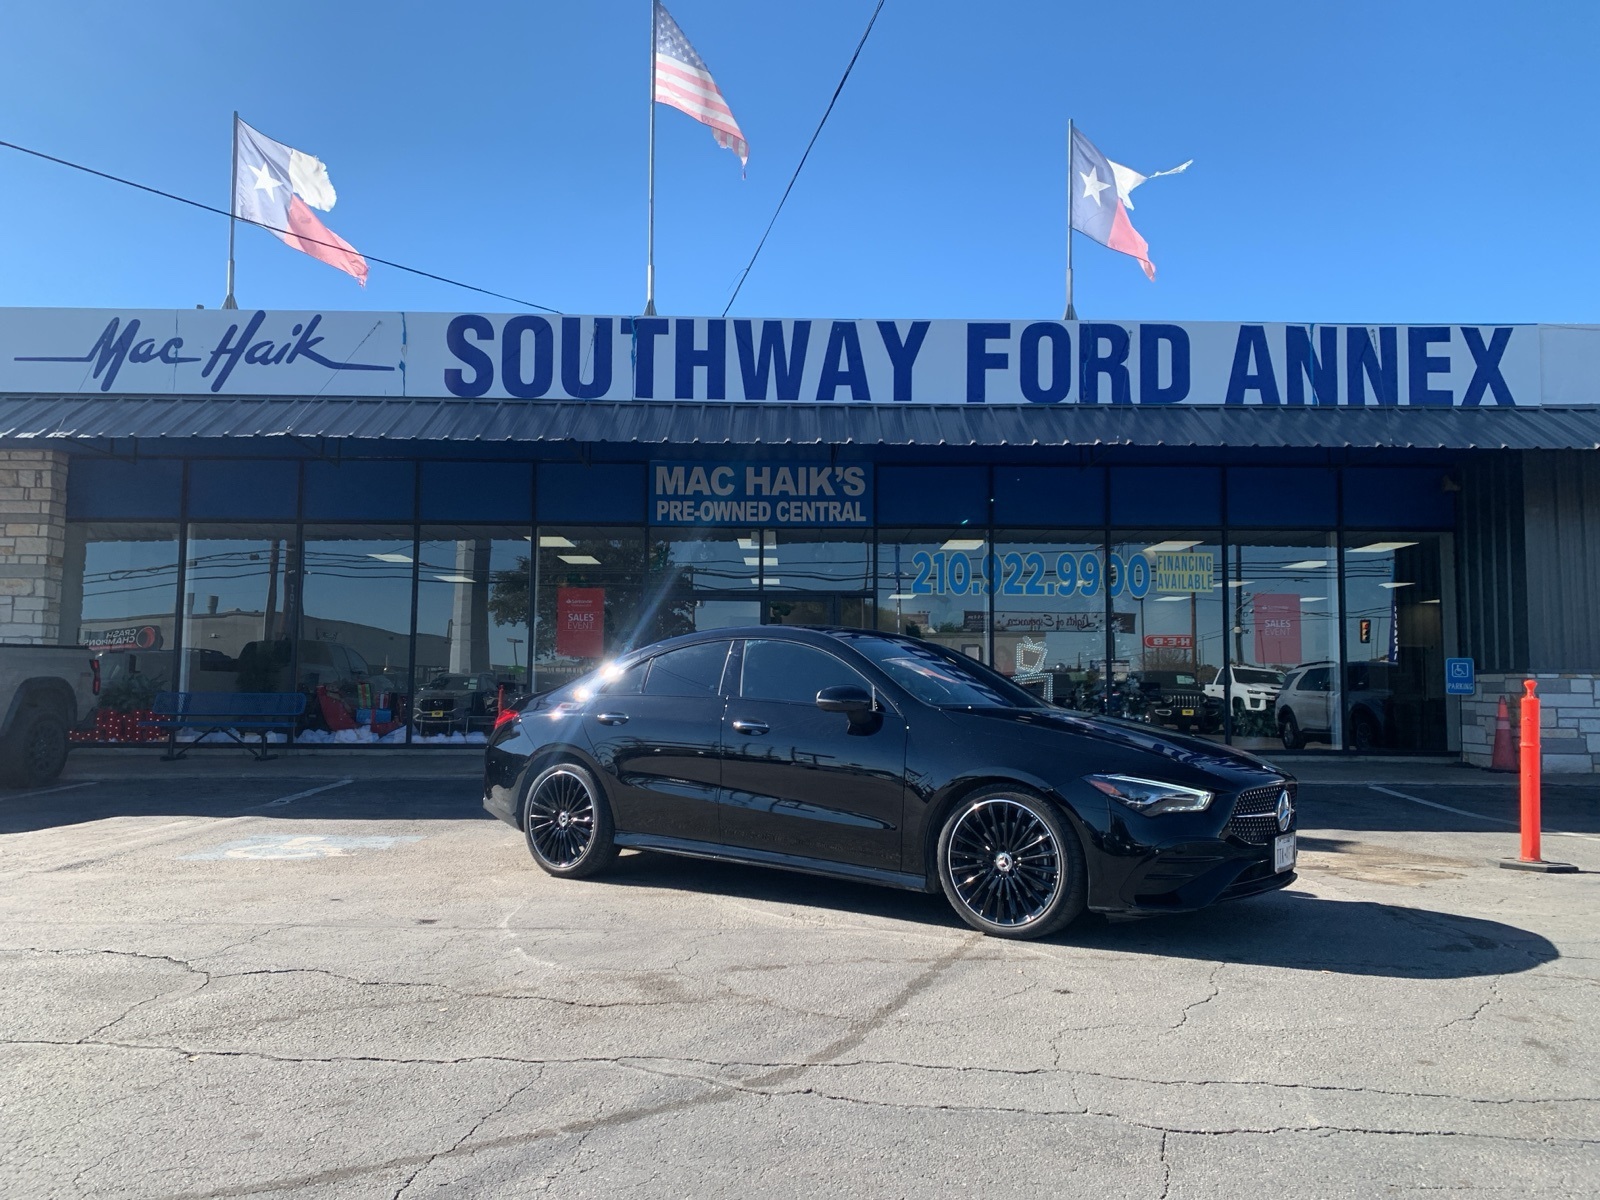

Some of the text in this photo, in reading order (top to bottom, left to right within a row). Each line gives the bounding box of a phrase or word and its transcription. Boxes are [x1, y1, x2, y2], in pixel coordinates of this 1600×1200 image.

[200, 309, 396, 393] Haik
[444, 314, 1516, 407] SOUTHWAY FORD ANNEX
[655, 466, 866, 496] MAC HAIK'S
[656, 501, 866, 522] PRE-OWNED CENTRAL
[1157, 555, 1212, 572] FINANCING
[911, 551, 1151, 598] 210.922.9900
[1157, 573, 1213, 590] AVAILABLE
[567, 621, 594, 630] EVENT
[568, 613, 594, 622] SALES
[1265, 619, 1291, 628] SALES
[1265, 627, 1291, 636] EVENT
[1448, 682, 1473, 690] PARKING
